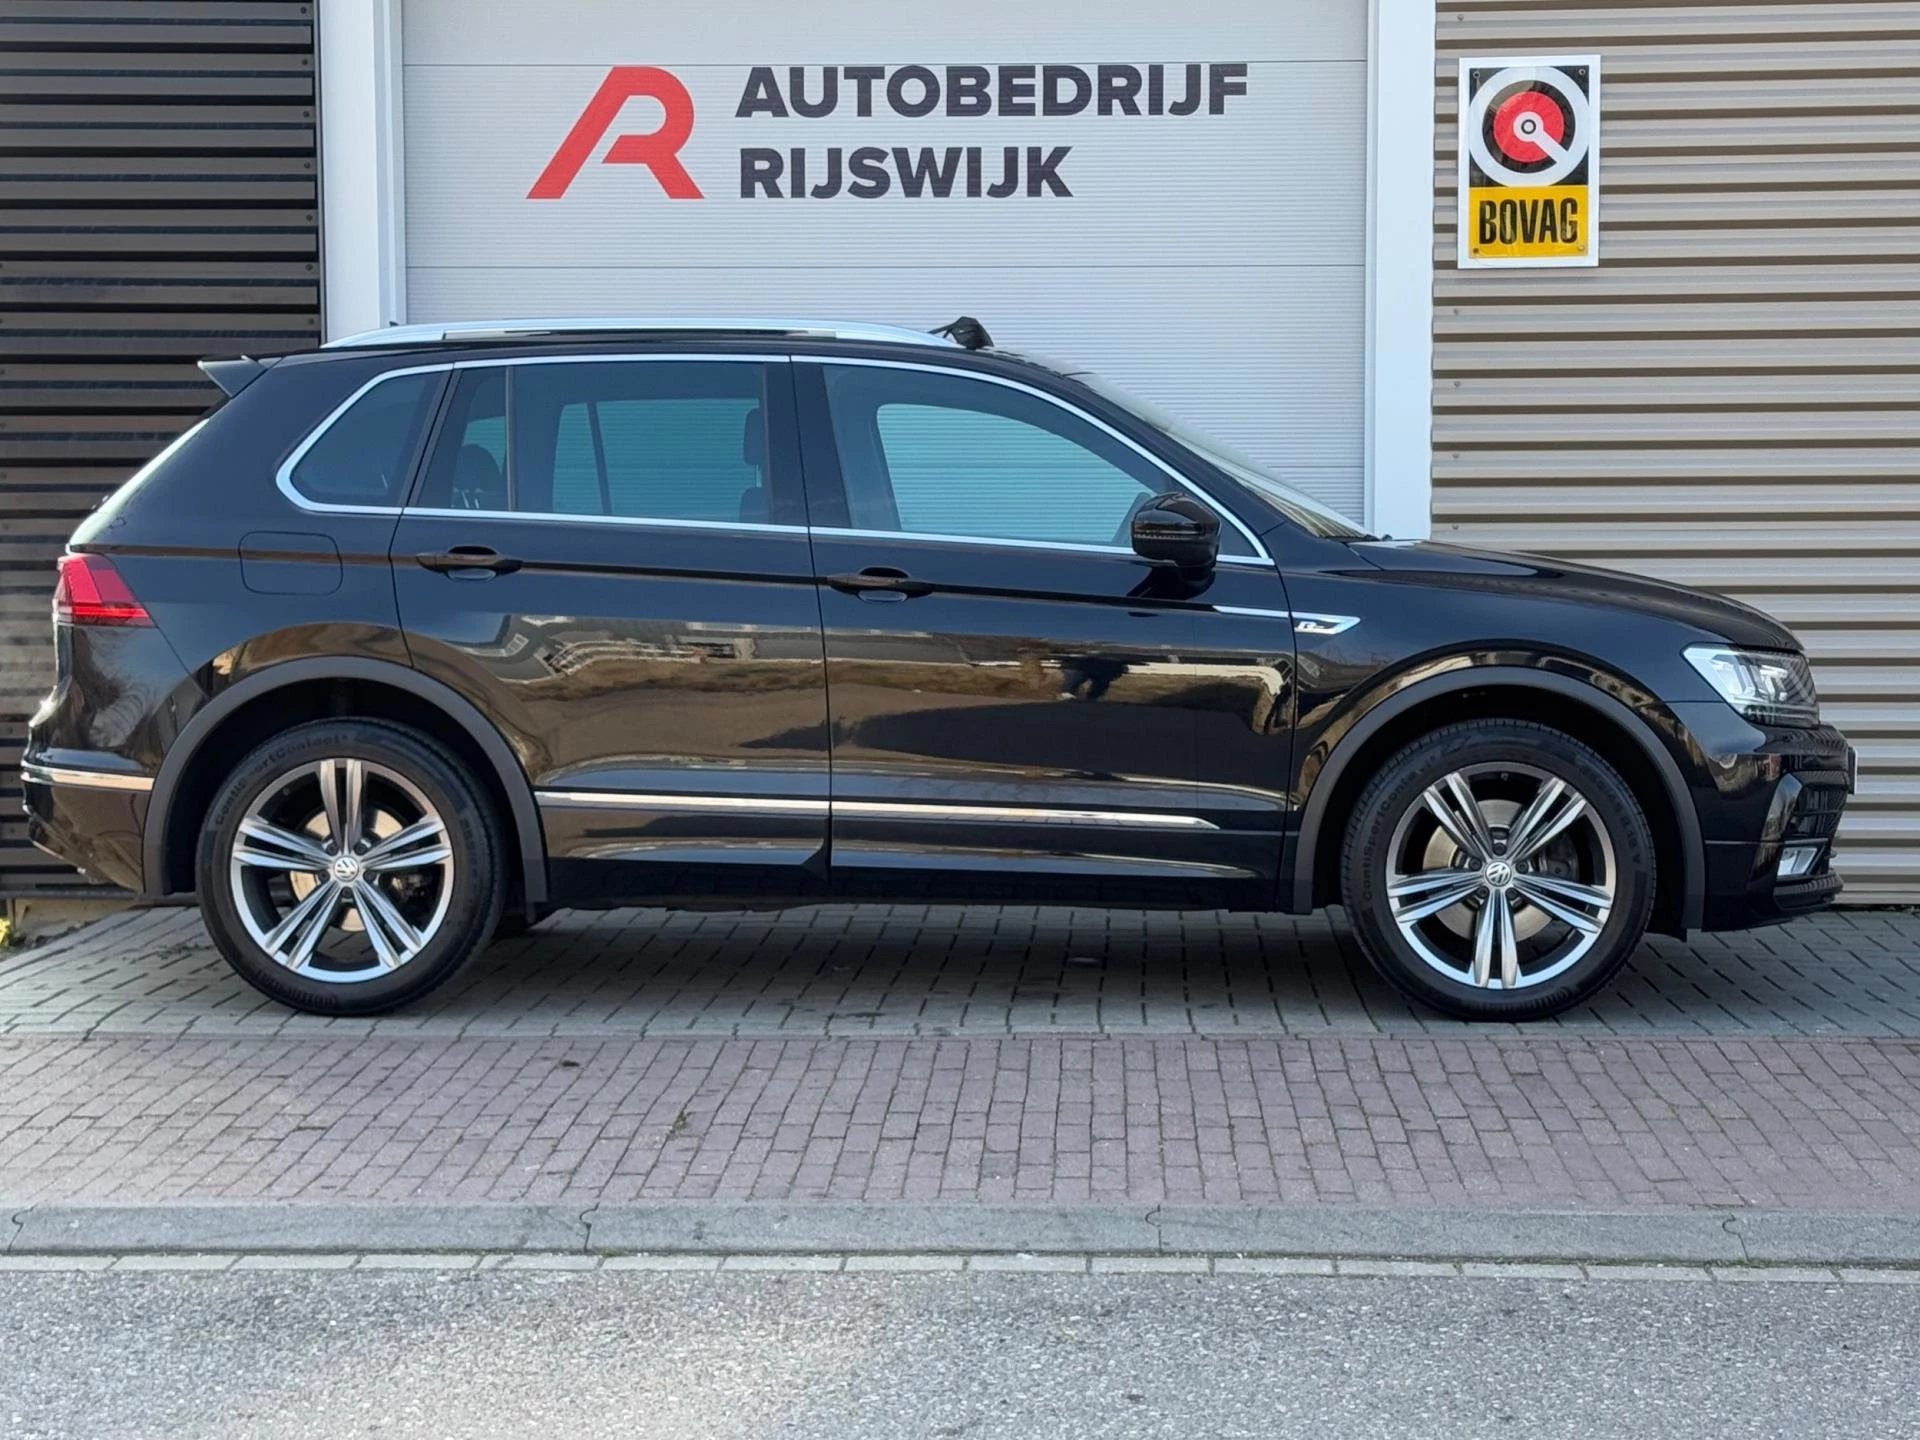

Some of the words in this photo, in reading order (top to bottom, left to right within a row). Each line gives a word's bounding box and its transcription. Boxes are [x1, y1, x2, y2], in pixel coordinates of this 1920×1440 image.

[734, 63, 1248, 118] AUTOBEDRIJF
[740, 146, 1074, 199] RIJSWIJK
[1479, 198, 1578, 244] BOVAG
